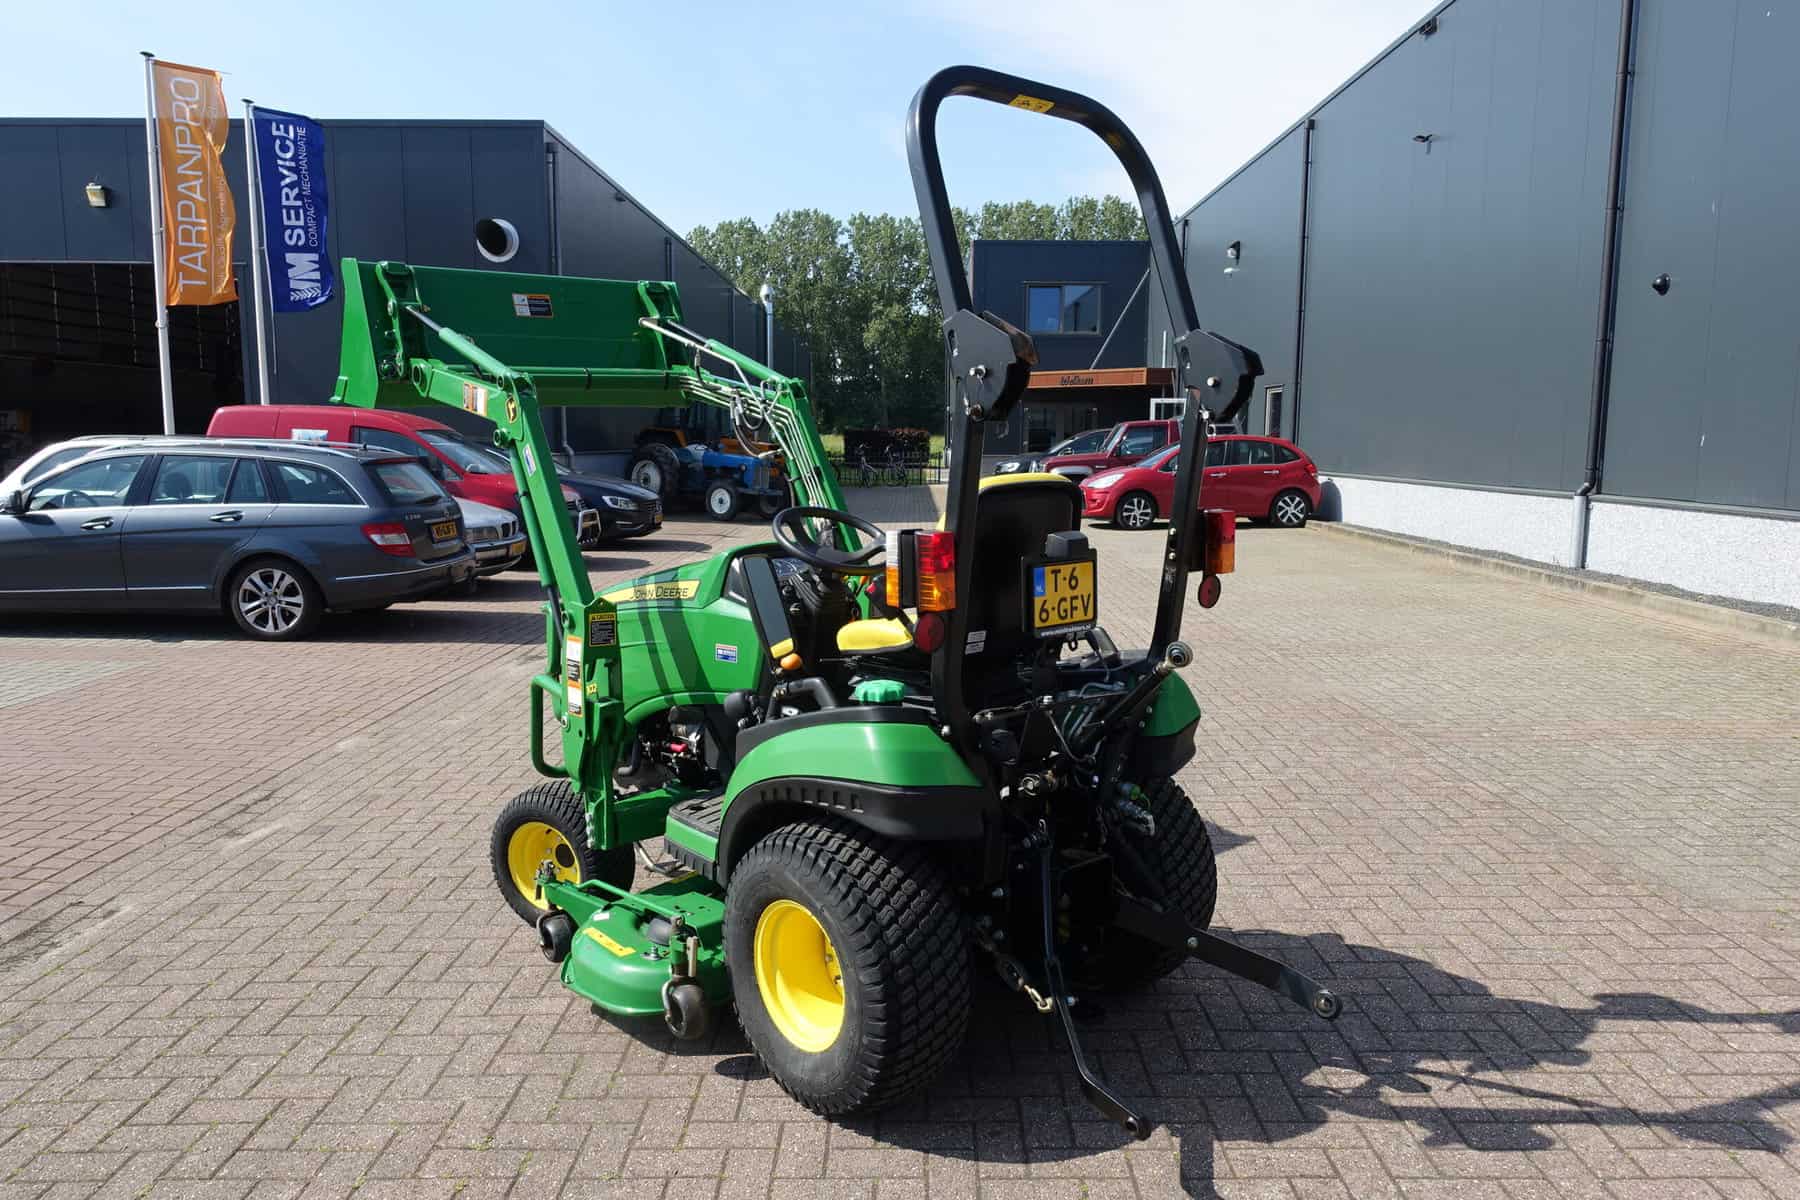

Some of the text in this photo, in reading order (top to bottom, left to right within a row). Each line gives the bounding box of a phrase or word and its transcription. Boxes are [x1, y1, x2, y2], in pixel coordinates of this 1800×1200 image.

[170, 77, 208, 292] TARPANPRO
[272, 121, 306, 246] SERVICE
[303, 199, 318, 247] COMPACT
[630, 586, 689, 599] JOHN DEERE
